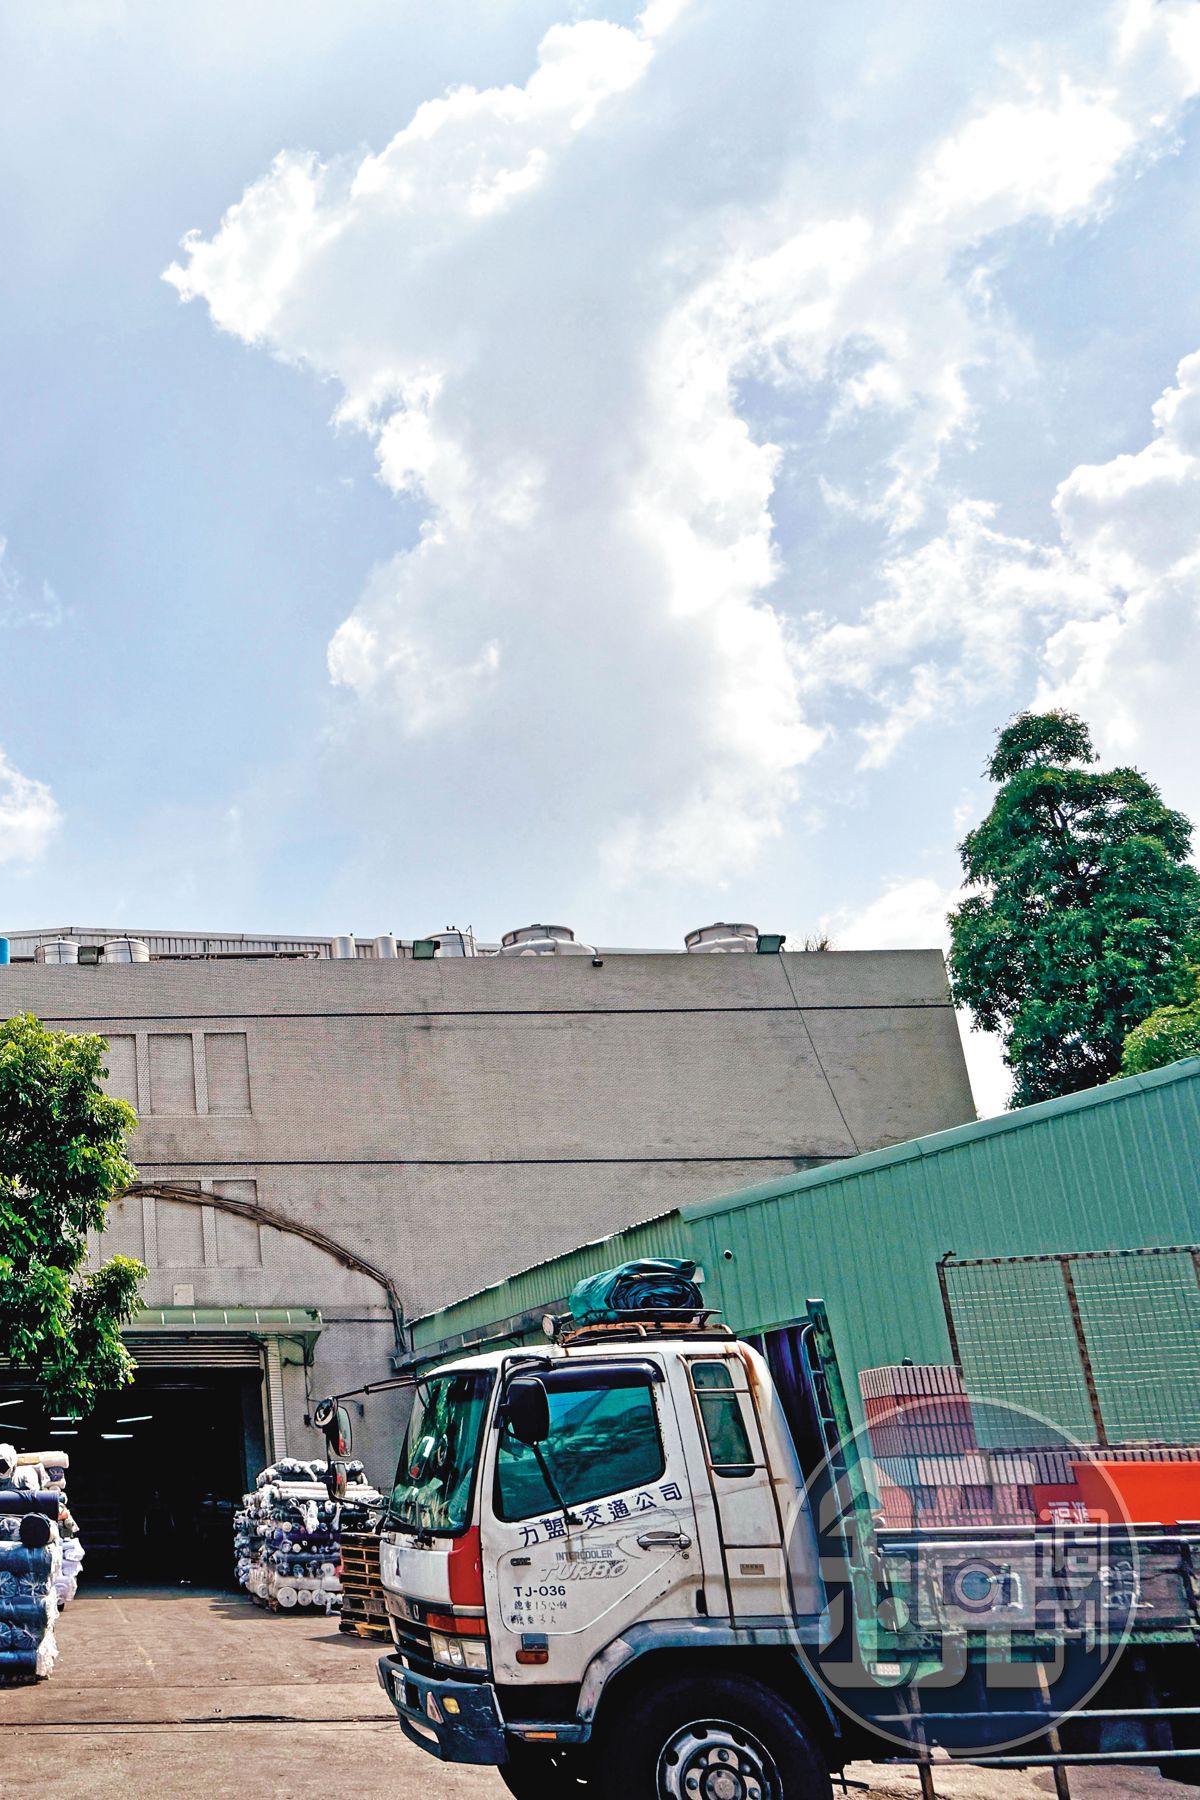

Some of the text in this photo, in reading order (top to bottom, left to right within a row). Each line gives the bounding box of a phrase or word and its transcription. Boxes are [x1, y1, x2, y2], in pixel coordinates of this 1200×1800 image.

[519, 1482, 683, 1548] 力盟交通公司
[555, 1549, 614, 1561] INTERCOOLER
[540, 1559, 629, 1582] TURBO
[513, 1585, 567, 1598] TJ-036
